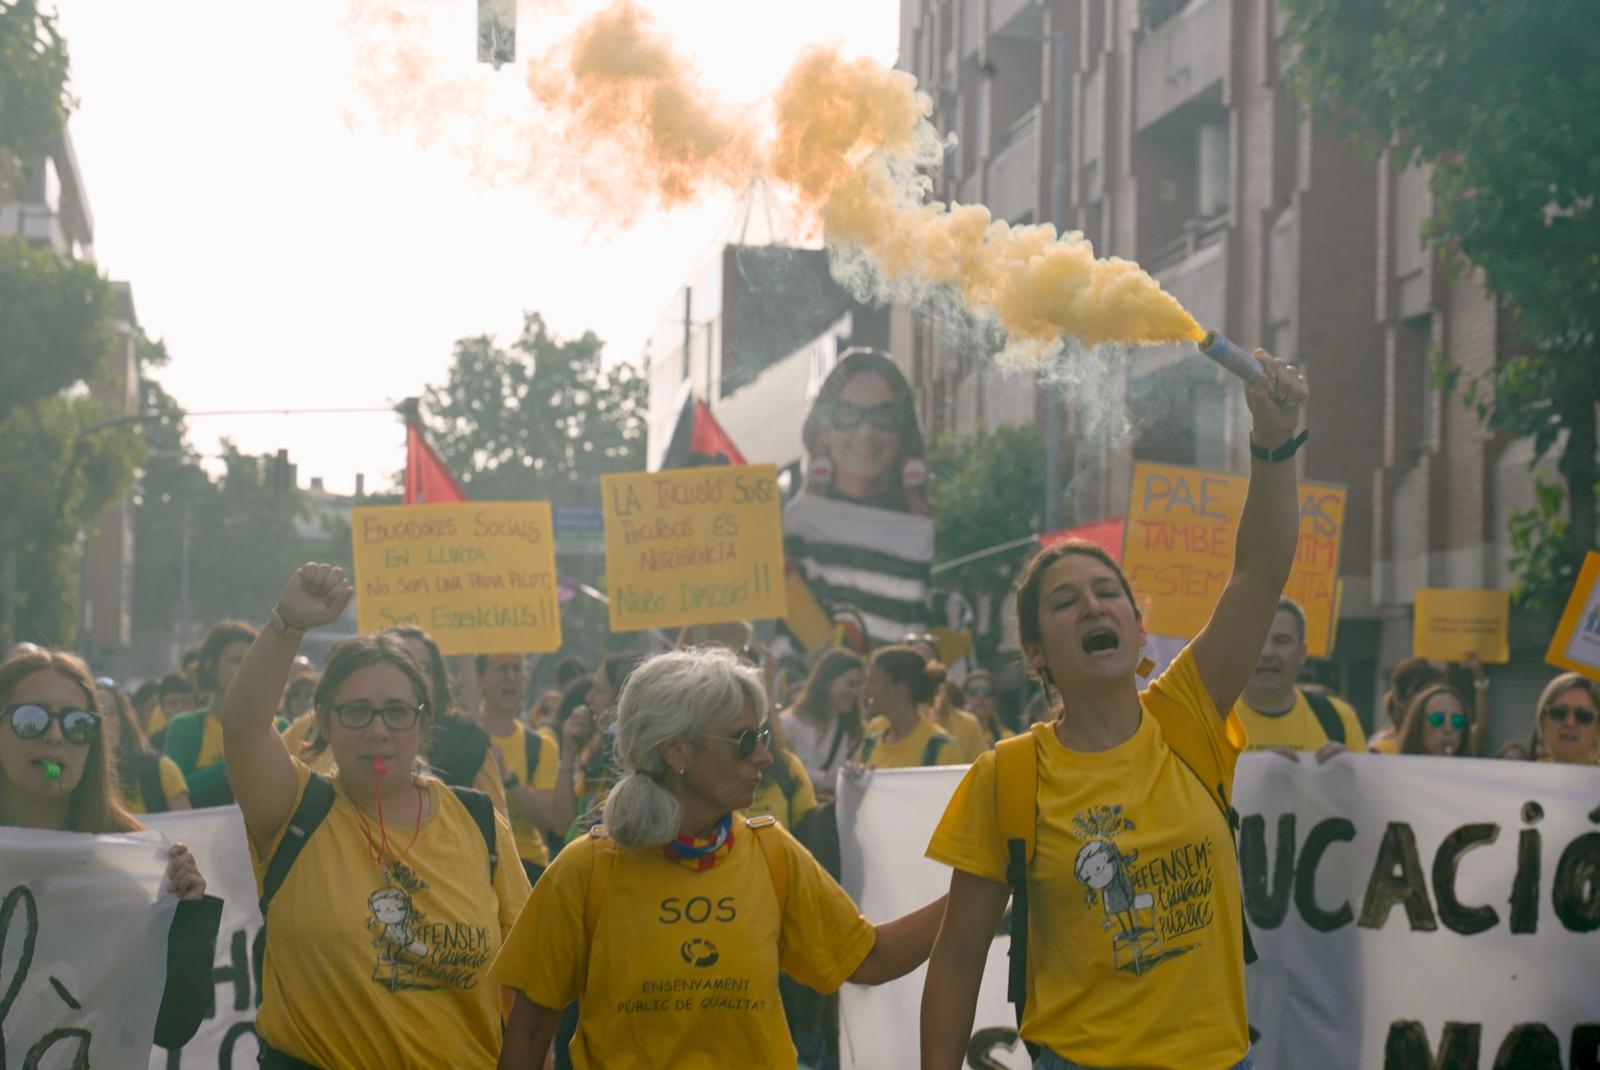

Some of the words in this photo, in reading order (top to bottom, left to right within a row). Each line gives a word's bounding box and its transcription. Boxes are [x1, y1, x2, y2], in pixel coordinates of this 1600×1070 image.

[613, 484, 642, 516] LA
[1142, 472, 1230, 519] PAE
[1300, 491, 1342, 538] AS
[1136, 516, 1233, 559] TAMBÉ
[384, 548, 410, 568] EN
[1129, 563, 1227, 599] ESTEM
[1240, 801, 1600, 935] UCACIÓ
[658, 896, 737, 924] SOS
[642, 978, 751, 993] ENSENYAMENT
[675, 1000, 693, 1010] DE
[700, 997, 766, 1012] QUALITAT
